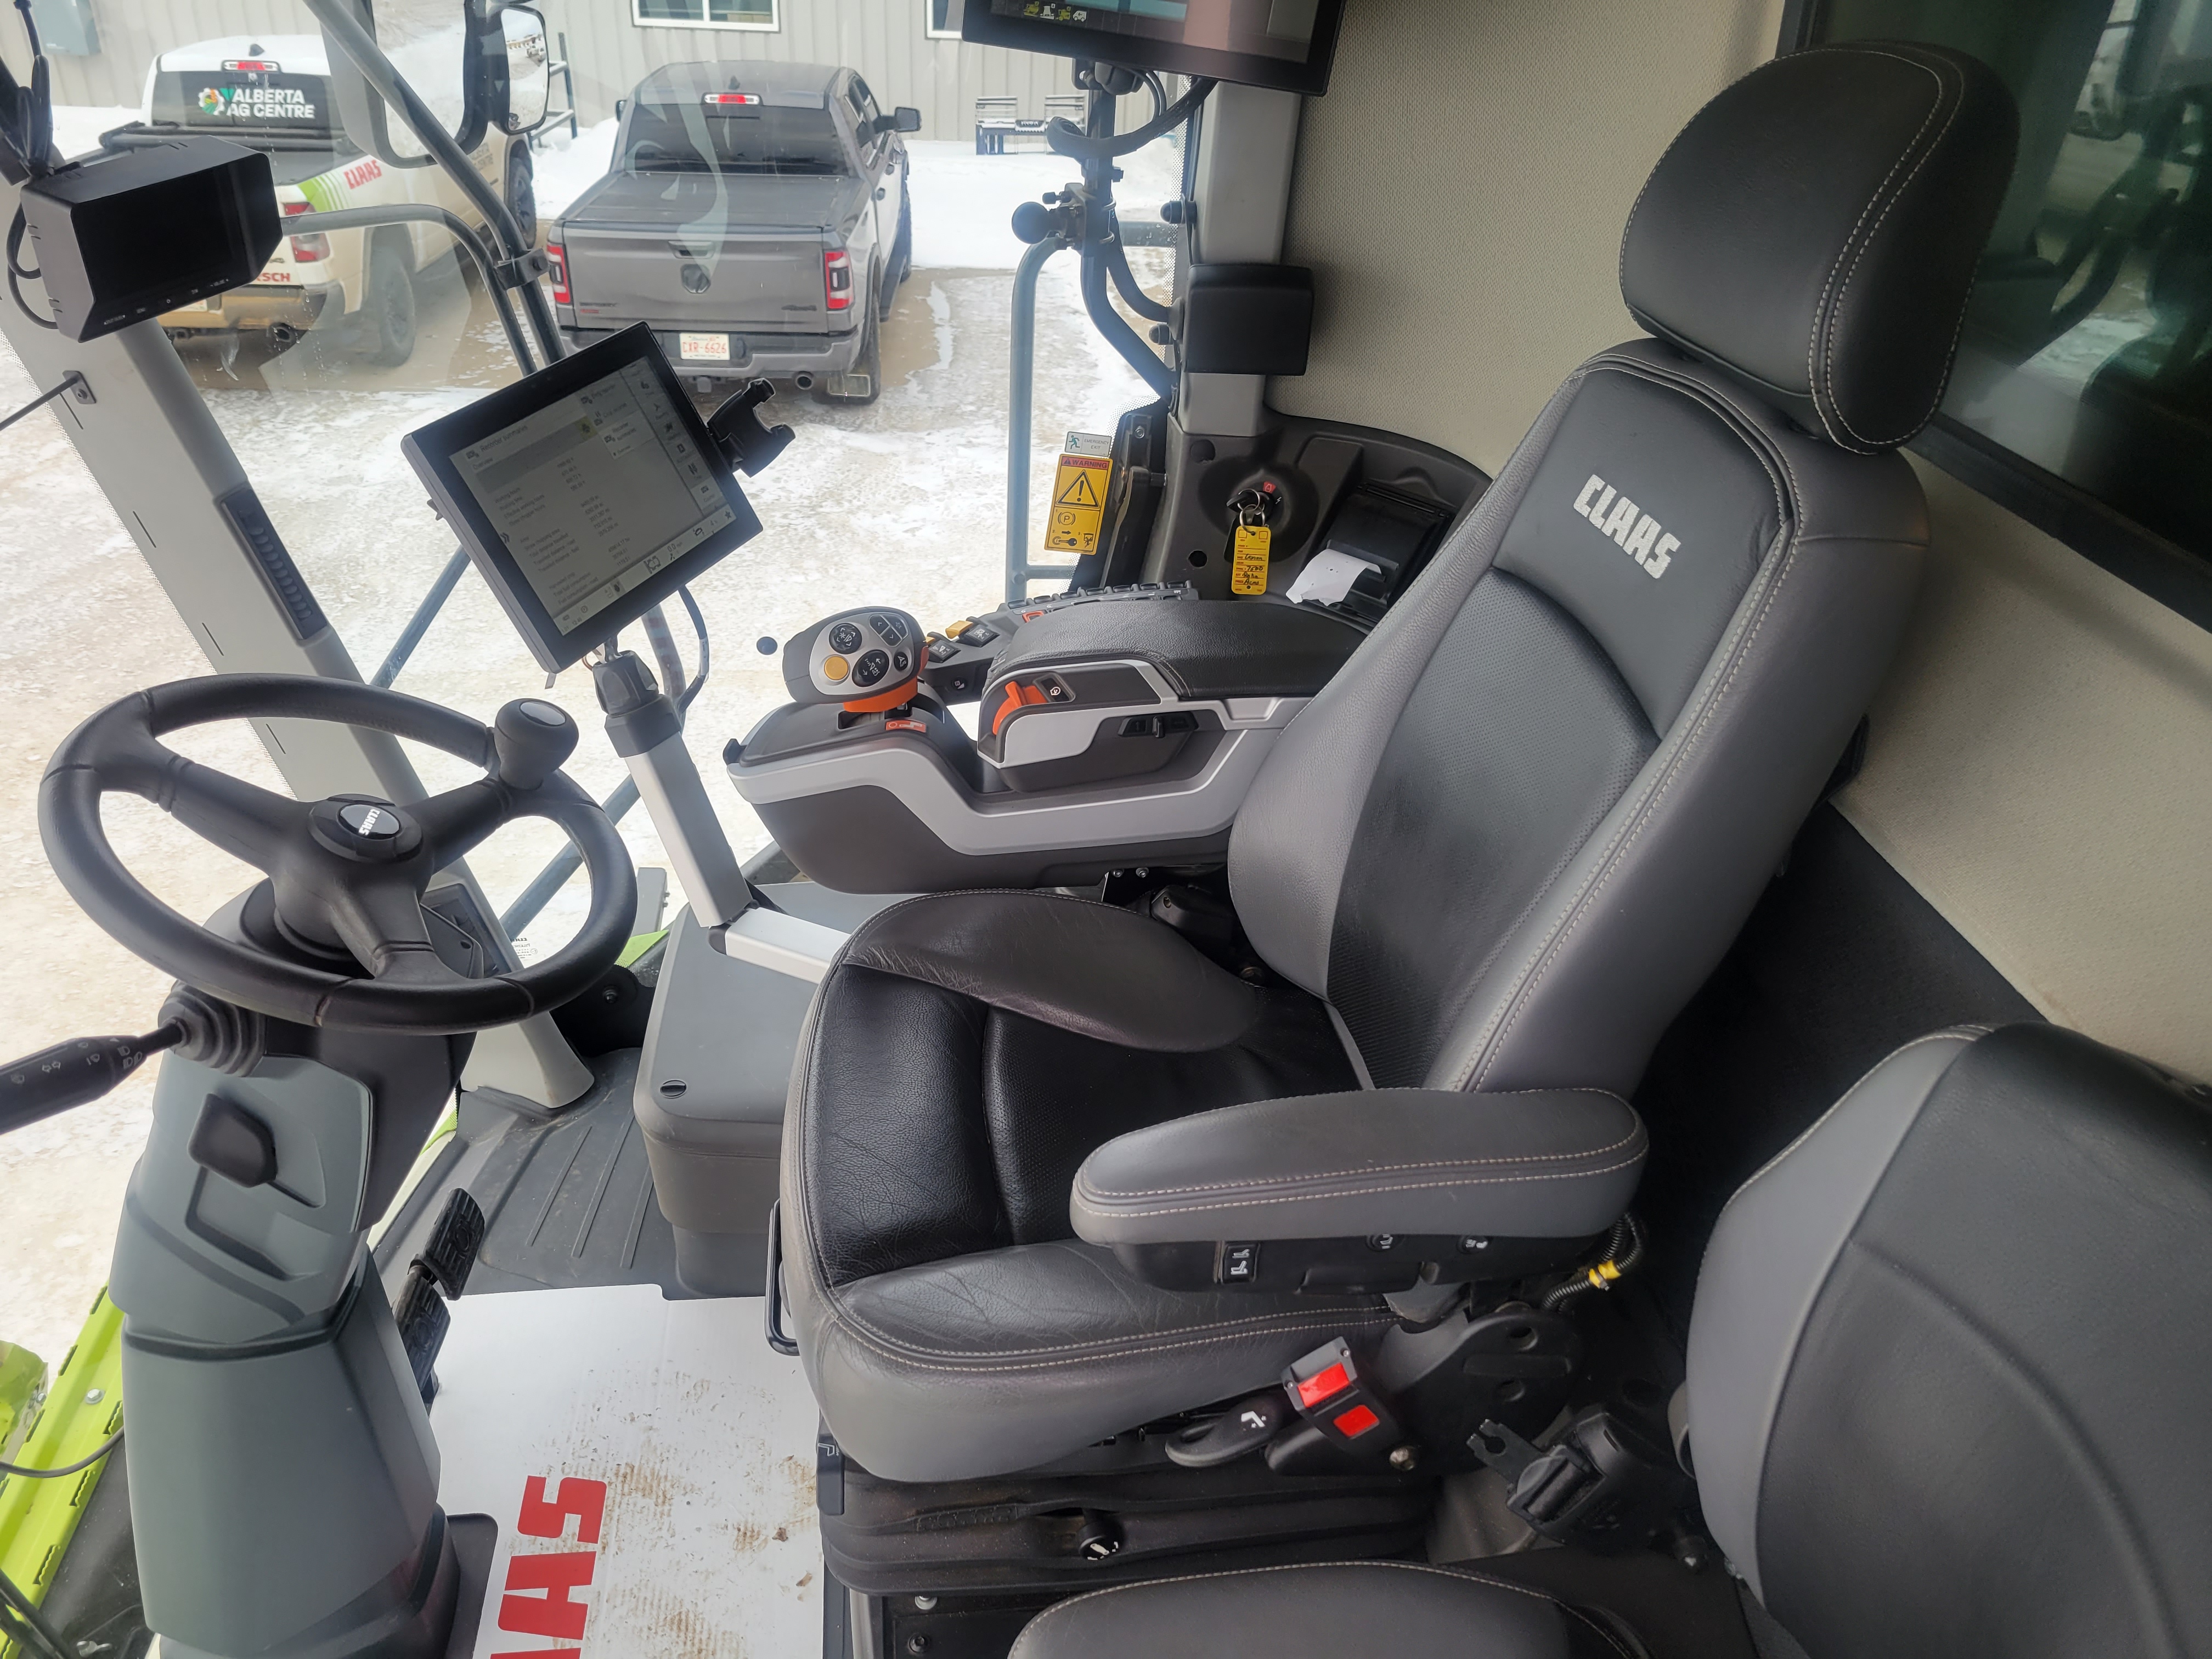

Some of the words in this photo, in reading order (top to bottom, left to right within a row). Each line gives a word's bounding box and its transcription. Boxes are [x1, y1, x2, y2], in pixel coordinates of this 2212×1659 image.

[232, 88, 306, 104] ALBERTA
[226, 103, 251, 117] AG
[253, 104, 315, 119] CENTRE
[343, 159, 382, 190] CLAAS
[256, 272, 290, 283] SCH
[479, 437, 503, 452] Recorder
[1072, 459, 1107, 469] WARNING
[1573, 473, 1682, 579] CLAAS
[358, 808, 381, 837] CLAAS
[490, 1475, 607, 1659] AS
